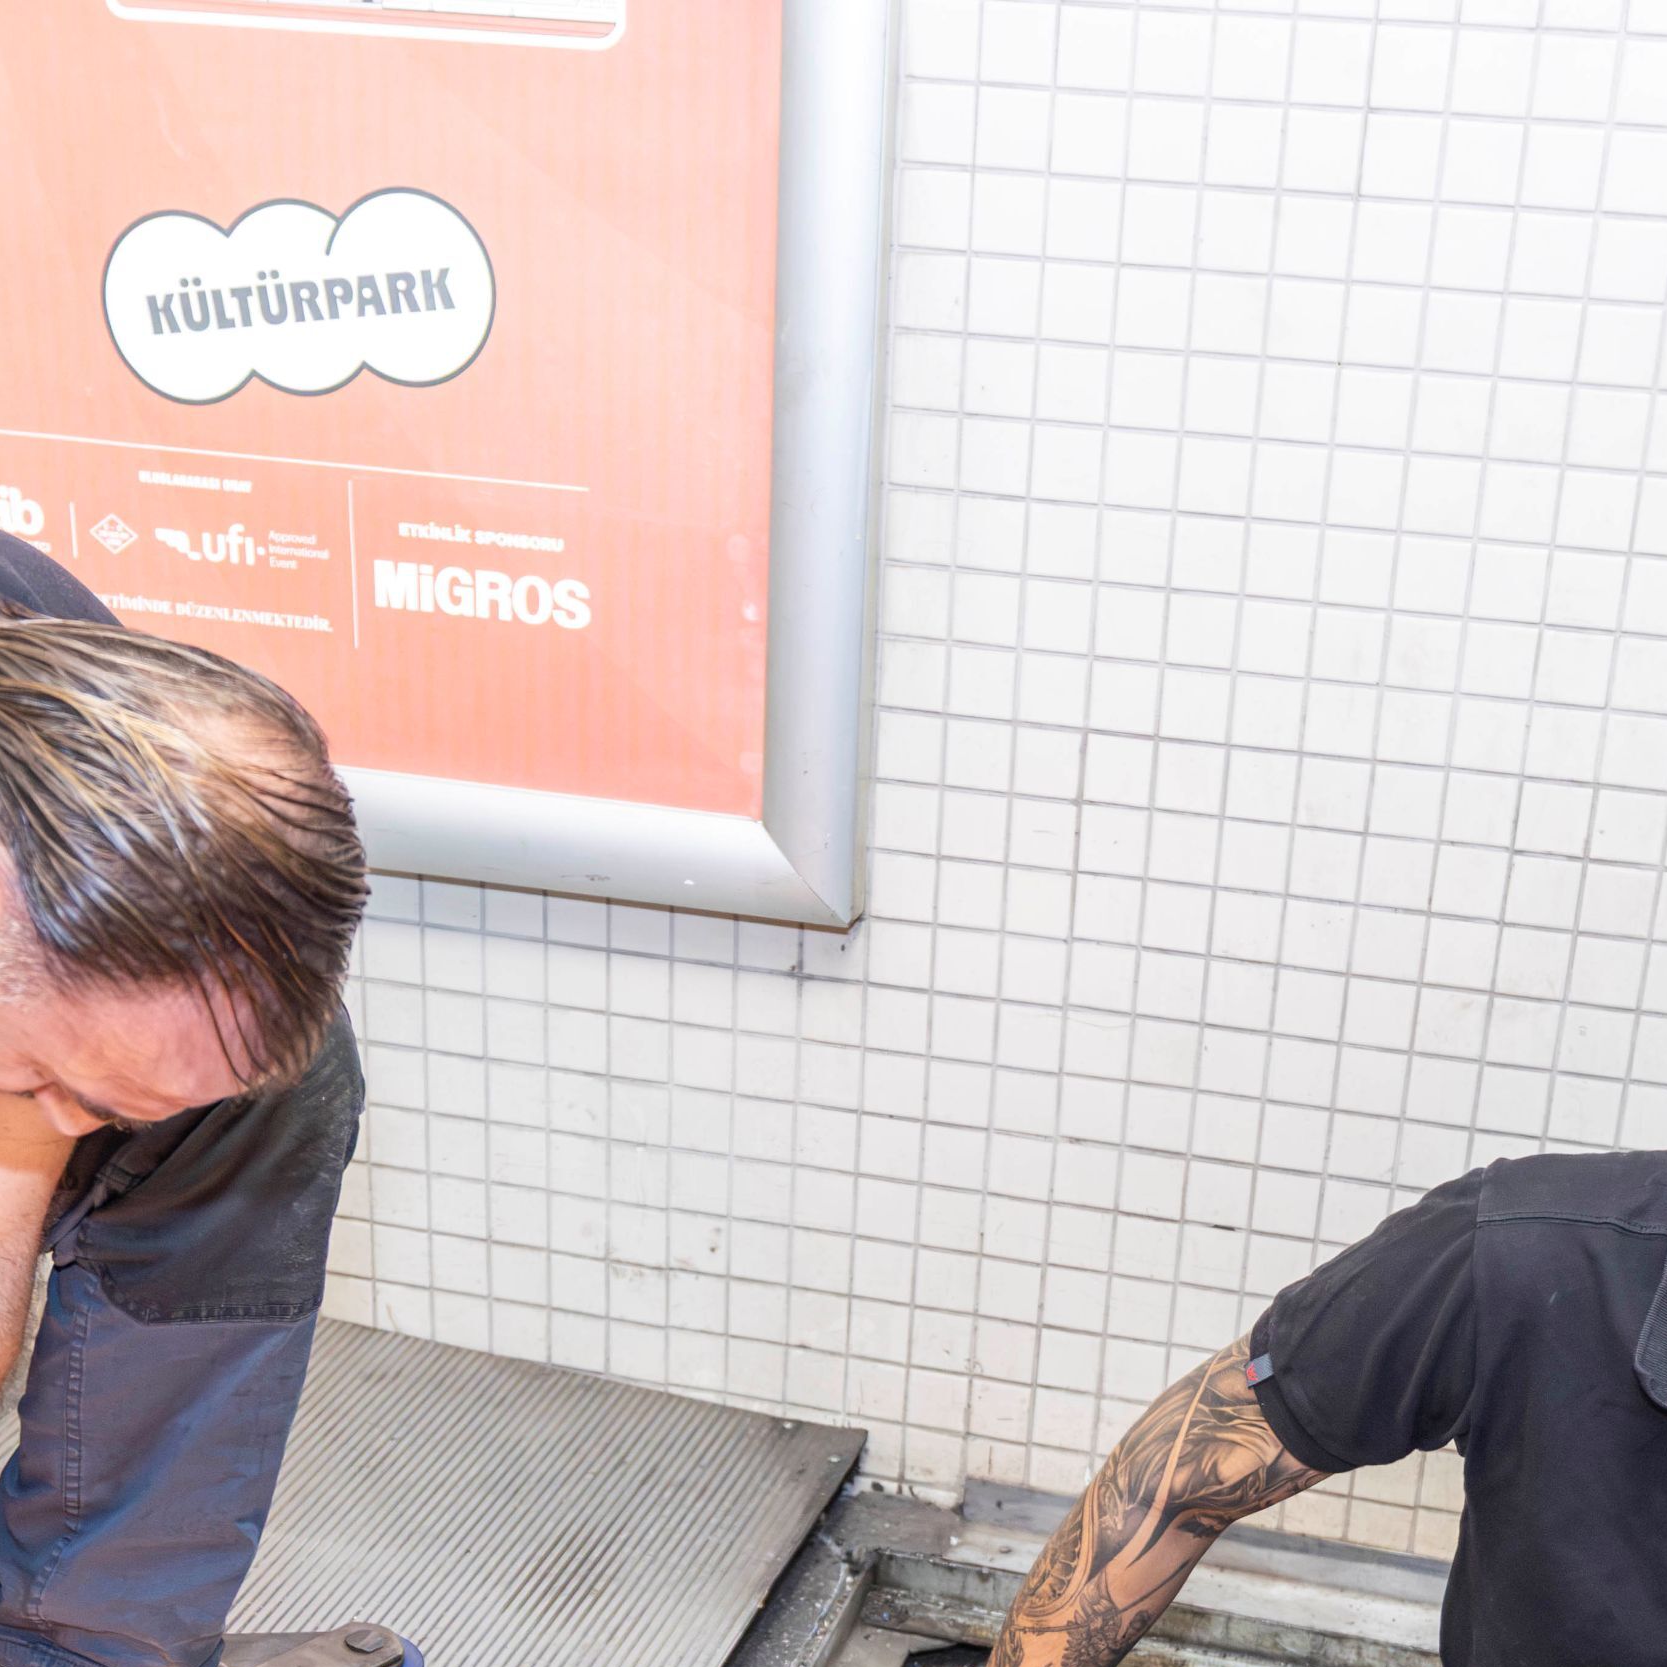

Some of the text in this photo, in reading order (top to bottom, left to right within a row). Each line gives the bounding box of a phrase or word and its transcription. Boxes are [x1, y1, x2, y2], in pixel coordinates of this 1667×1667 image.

[146, 267, 456, 335] KÜLTÜRPARK
[268, 530, 318, 549] Approved
[268, 544, 331, 561] International
[269, 556, 299, 570] Event
